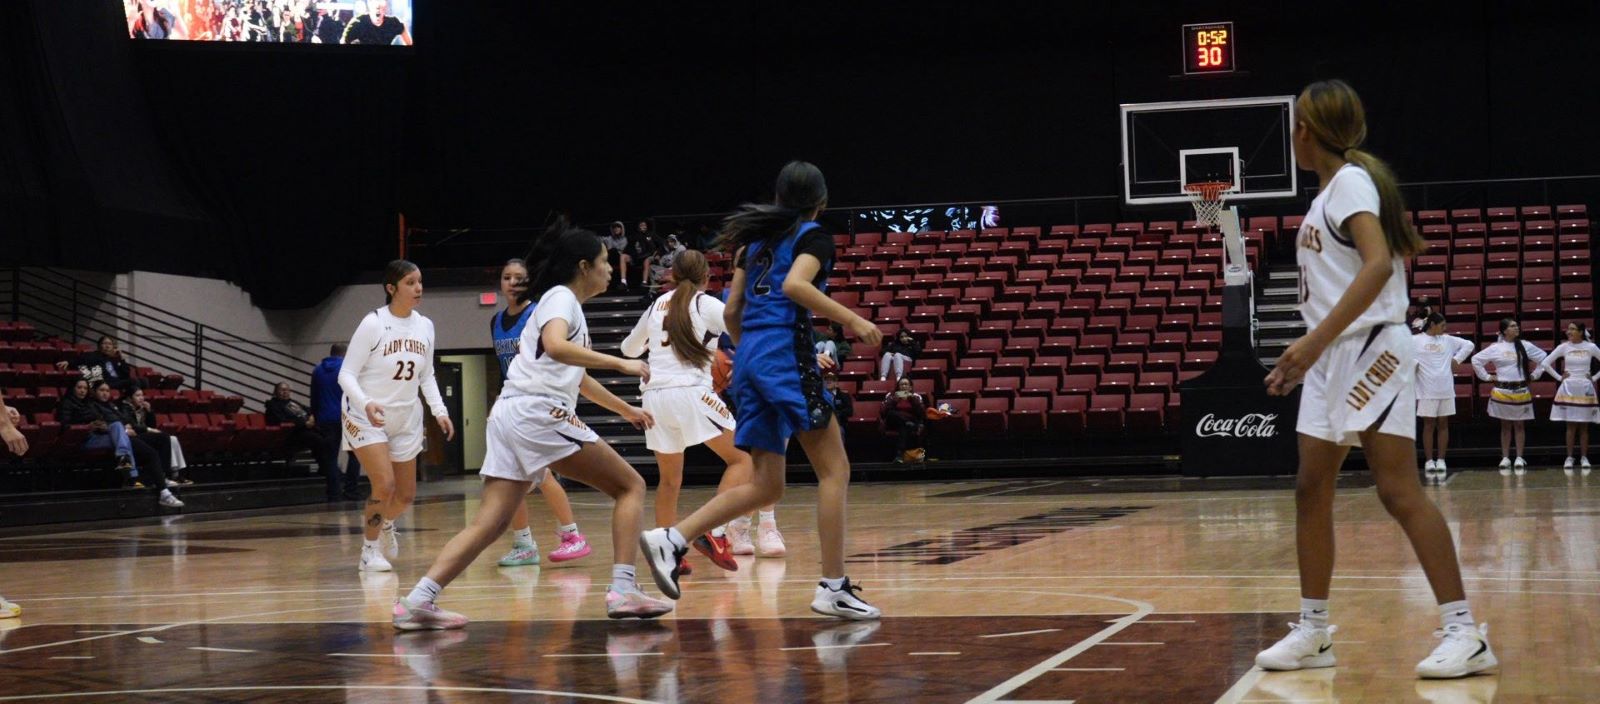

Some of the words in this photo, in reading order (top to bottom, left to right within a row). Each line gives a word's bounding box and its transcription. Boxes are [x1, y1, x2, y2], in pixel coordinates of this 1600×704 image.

[1197, 30, 1227, 46] 0:52
[1197, 46, 1222, 66] 30
[383, 339, 402, 356] LADY
[404, 339, 426, 356] CHIEFS
[392, 360, 416, 381] 23
[1345, 379, 1376, 412] LADY
[1364, 350, 1400, 387] CHIEFS
[1195, 413, 1278, 438] Coca-Cola
